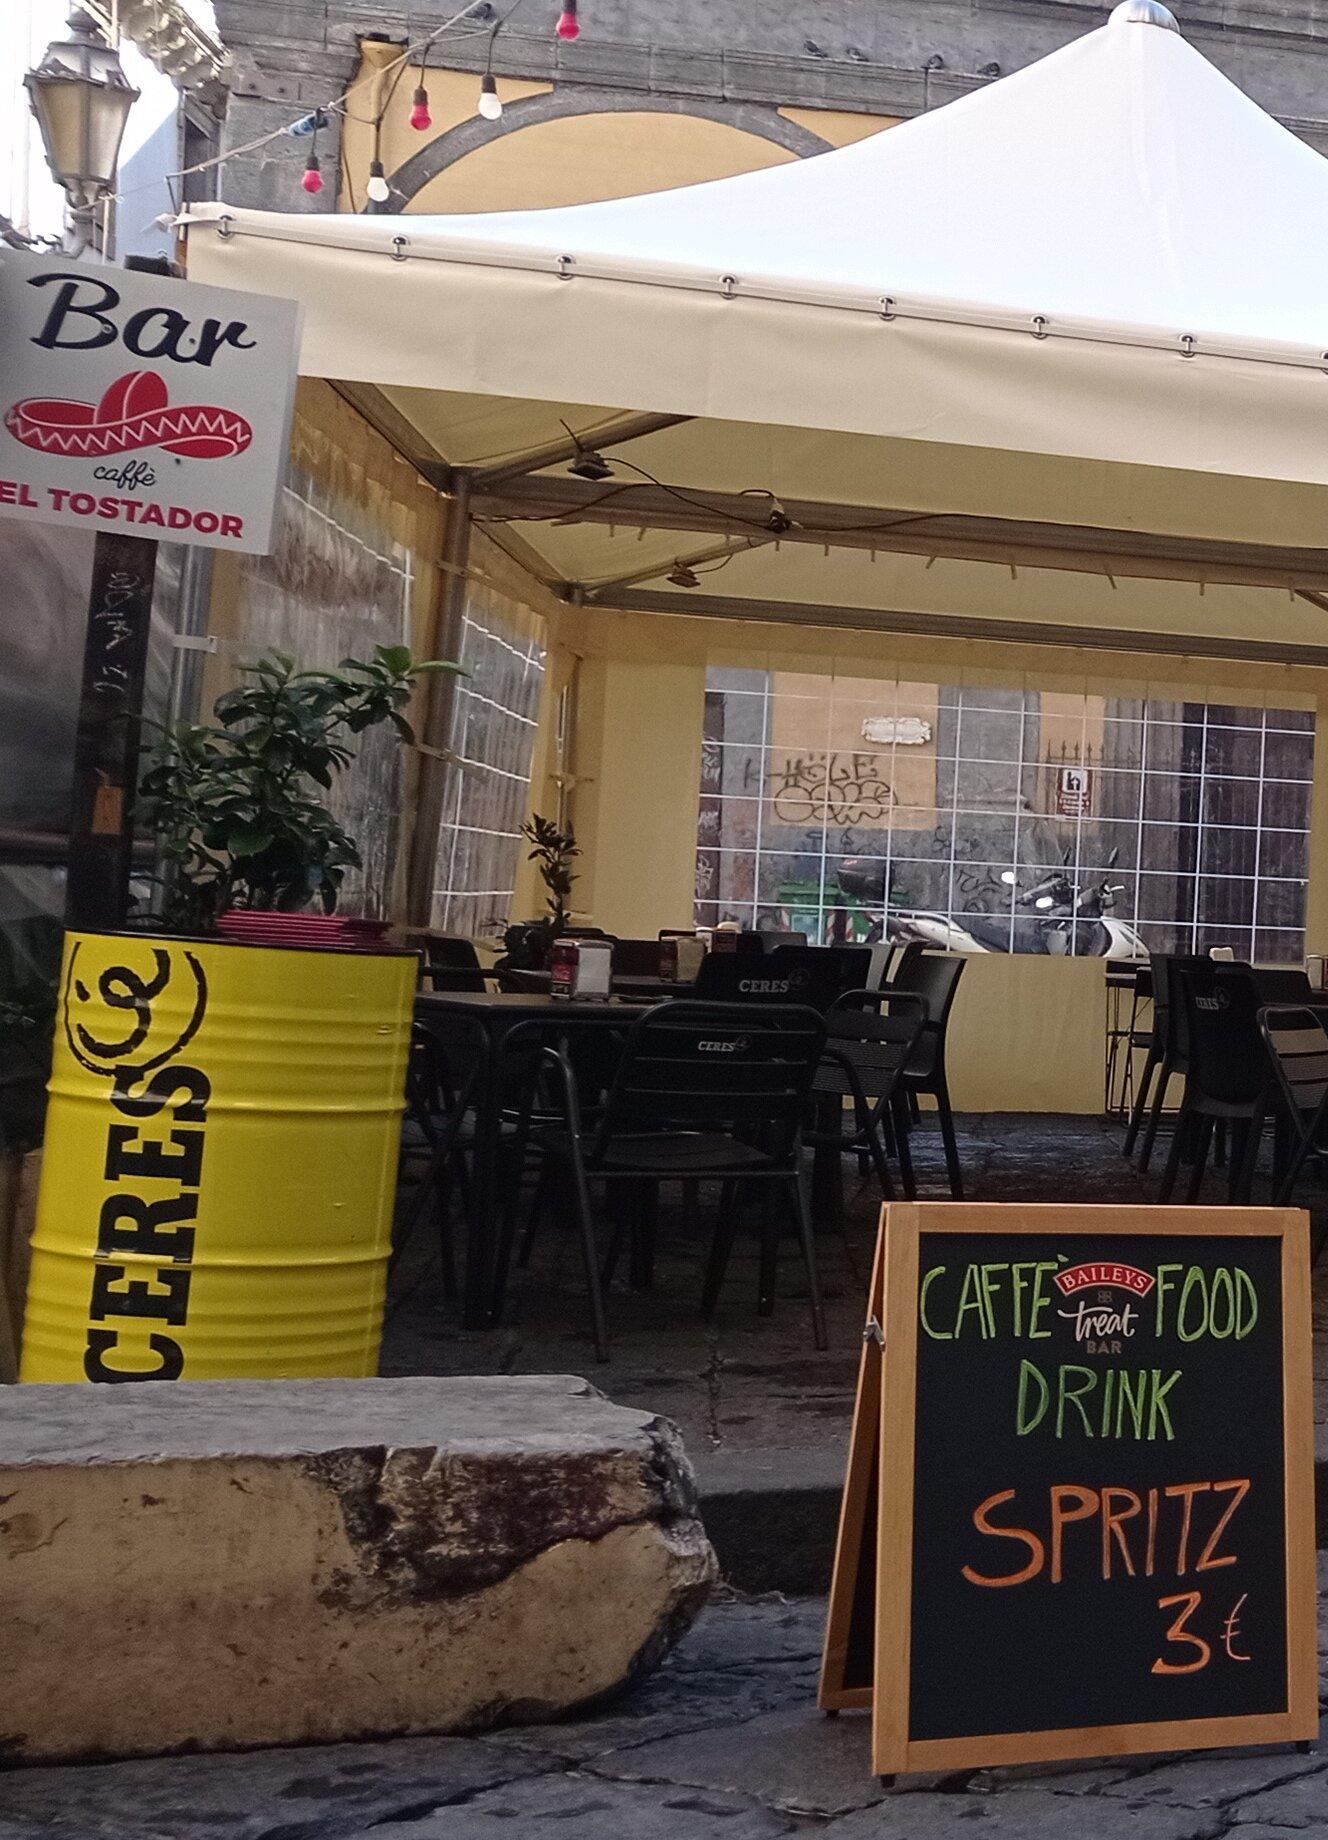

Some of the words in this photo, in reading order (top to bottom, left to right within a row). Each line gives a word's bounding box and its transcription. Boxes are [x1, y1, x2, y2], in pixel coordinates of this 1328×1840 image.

[26, 273, 257, 367] Bar
[93, 460, 156, 491] caffè
[47, 488, 244, 539] TOSTADOR
[740, 980, 790, 993] CERES
[698, 1041, 736, 1052] CERES
[84, 1064, 212, 1383] CERES
[1063, 1266, 1148, 1291] BAILEYS
[1057, 1300, 1139, 1342] treat
[1155, 1263, 1259, 1342] FOOD
[1086, 1340, 1123, 1354] BAR
[1016, 1359, 1182, 1440] DRINK
[962, 1479, 1250, 1587] SPRITZ
